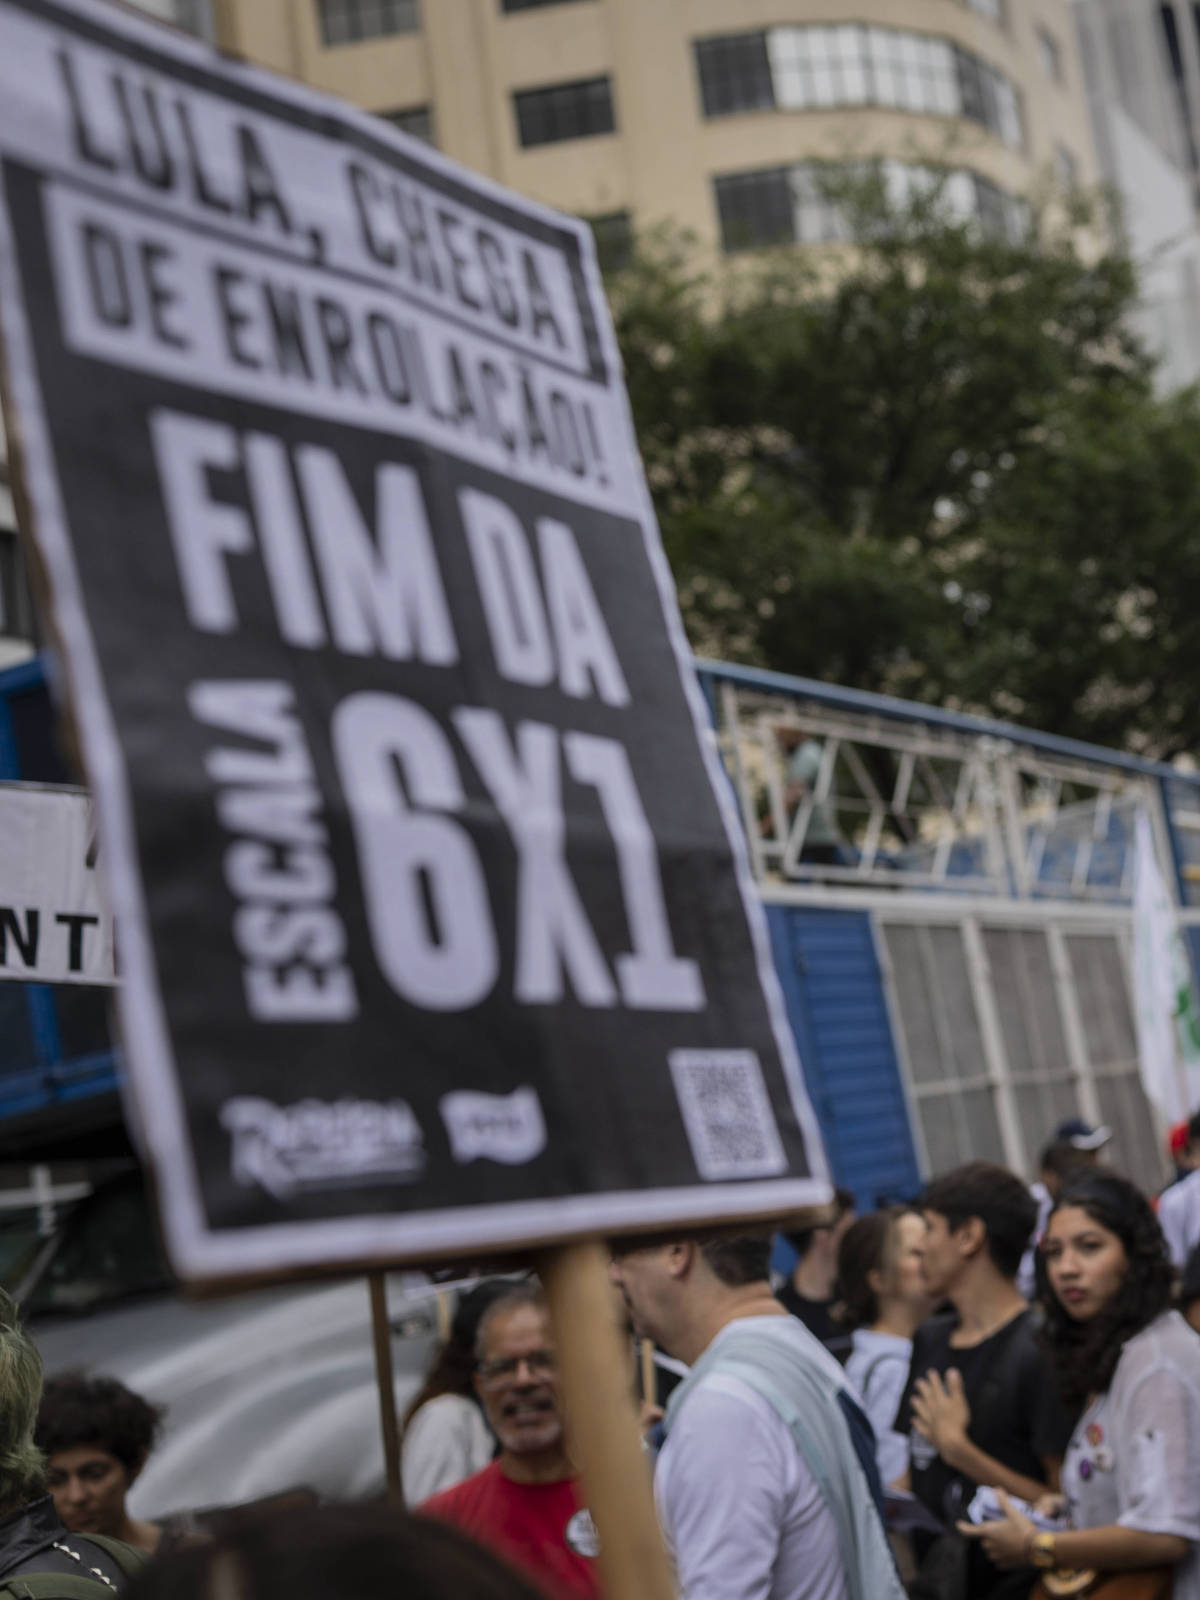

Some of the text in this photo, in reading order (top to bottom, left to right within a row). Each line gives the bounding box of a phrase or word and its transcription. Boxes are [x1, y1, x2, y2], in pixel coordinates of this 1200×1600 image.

[56, 46, 567, 349] LULA, CHEGA
[81, 219, 610, 486] DE ENROLAÇÃO!
[150, 407, 630, 708] FIM DA
[190, 679, 358, 1023] ESCALA
[330, 689, 706, 1011] 6X1
